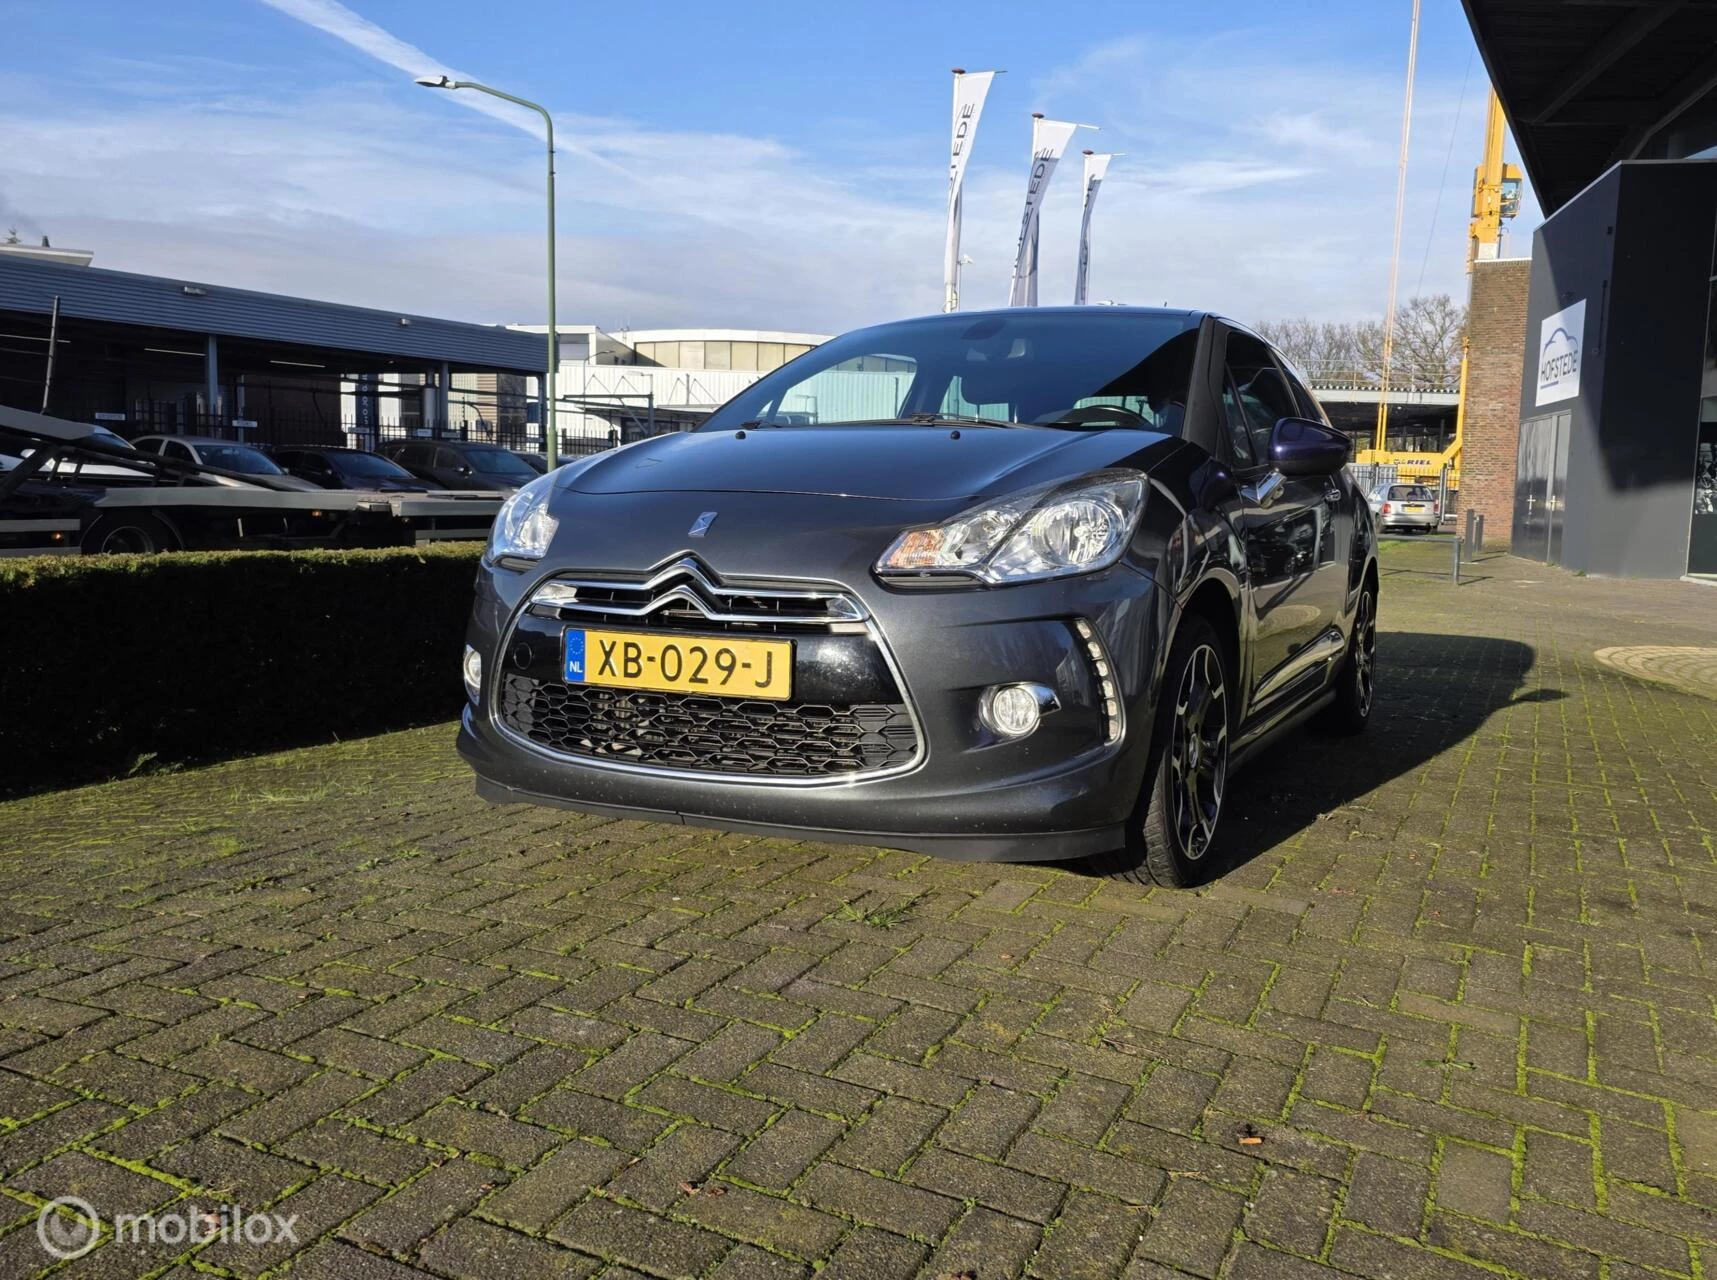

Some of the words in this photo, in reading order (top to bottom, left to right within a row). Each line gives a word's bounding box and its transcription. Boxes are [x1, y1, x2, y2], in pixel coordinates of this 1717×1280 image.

[1541, 350, 1578, 382] HOFSTEDE
[569, 661, 583, 674] NL
[598, 640, 773, 688] XB-029-J
